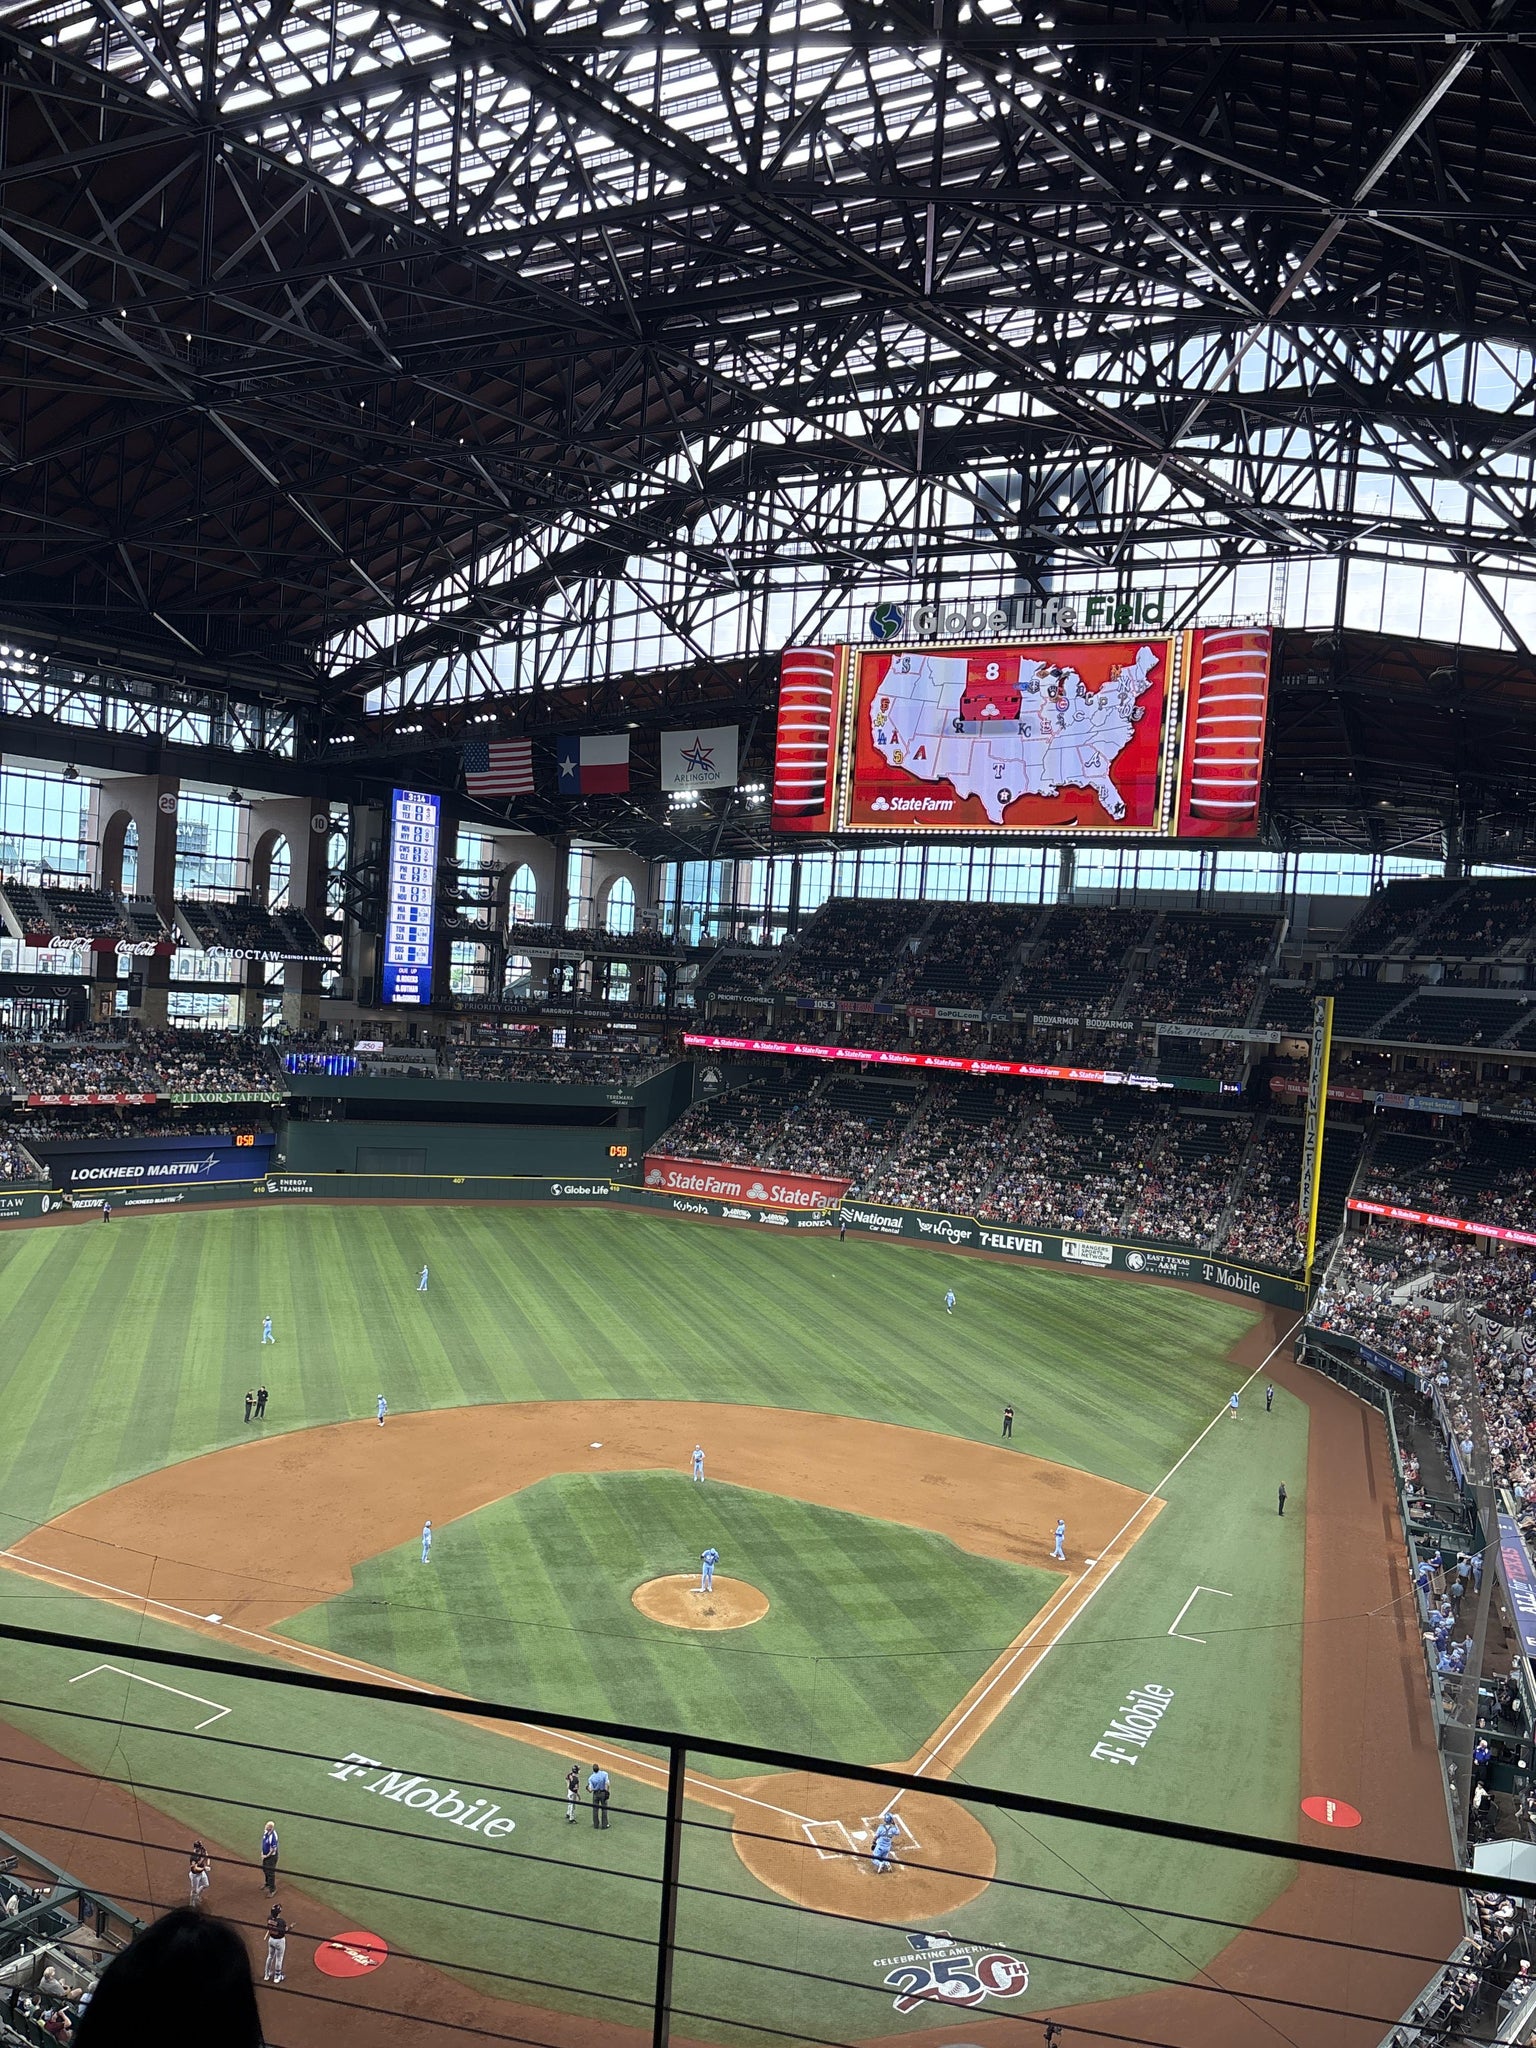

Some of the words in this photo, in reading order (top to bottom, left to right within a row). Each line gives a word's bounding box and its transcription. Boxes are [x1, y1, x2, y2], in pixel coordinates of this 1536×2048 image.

[913, 604, 1008, 634] Globe
[1015, 597, 1077, 629] Life
[1085, 592, 1165, 626] Field
[986, 663, 999, 680] 8
[1084, 751, 1101, 767] A
[993, 763, 1005, 778] T
[674, 772, 720, 783] ARLINGTON
[161, 796, 175, 809] 29
[408, 793, 426, 802] 3:14
[314, 818, 325, 829] 10
[48, 936, 94, 952] Coca-Cola
[115, 940, 158, 956] Coca-Cola
[215, 947, 280, 960] CHOCTAW
[717, 994, 742, 1002] PRIORITY
[743, 996, 774, 1004] COMMERCE
[813, 1000, 836, 1010] 105.3
[464, 1002, 501, 1011] PRIORITY
[504, 1004, 527, 1013] GOLD
[623, 1012, 667, 1020] PLUCKERS
[937, 1010, 979, 1019] GoPGL.com
[990, 1013, 1010, 1022] PGL
[1033, 1015, 1080, 1026] BODYARMOR
[1085, 1019, 1134, 1030] BODYARMOR
[1158, 1024, 1183, 1036] Blue
[1309, 1030, 1322, 1110] CHIKIN
[183, 1093, 223, 1102] LUXOR
[224, 1092, 280, 1102] STAFFING
[71, 1166, 144, 1180] LOCKHEED
[147, 1163, 199, 1176] MARTIN
[1303, 1154, 1312, 1209] FARE
[564, 1185, 590, 1194] Globe
[592, 1186, 609, 1194] Life
[673, 1200, 709, 1215] Kubota
[798, 1219, 832, 1228] HONDA
[853, 1210, 903, 1228] National
[881, 1226, 900, 1234] Rental
[933, 1219, 972, 1244] Kroger
[1065, 1242, 1077, 1256] T
[1081, 1244, 1109, 1252] RANGERS
[1081, 1253, 1110, 1261] NETWORK
[1146, 1254, 1164, 1263] EAST
[1166, 1256, 1190, 1266] TEXAS
[1158, 1261, 1177, 1270] A&M
[1145, 1267, 1190, 1278] UNIVERSITY
[1502, 1548, 1528, 1581] TEXAS
[1515, 1592, 1536, 1615] ALL
[873, 1950, 946, 1967] CELEBRATING
